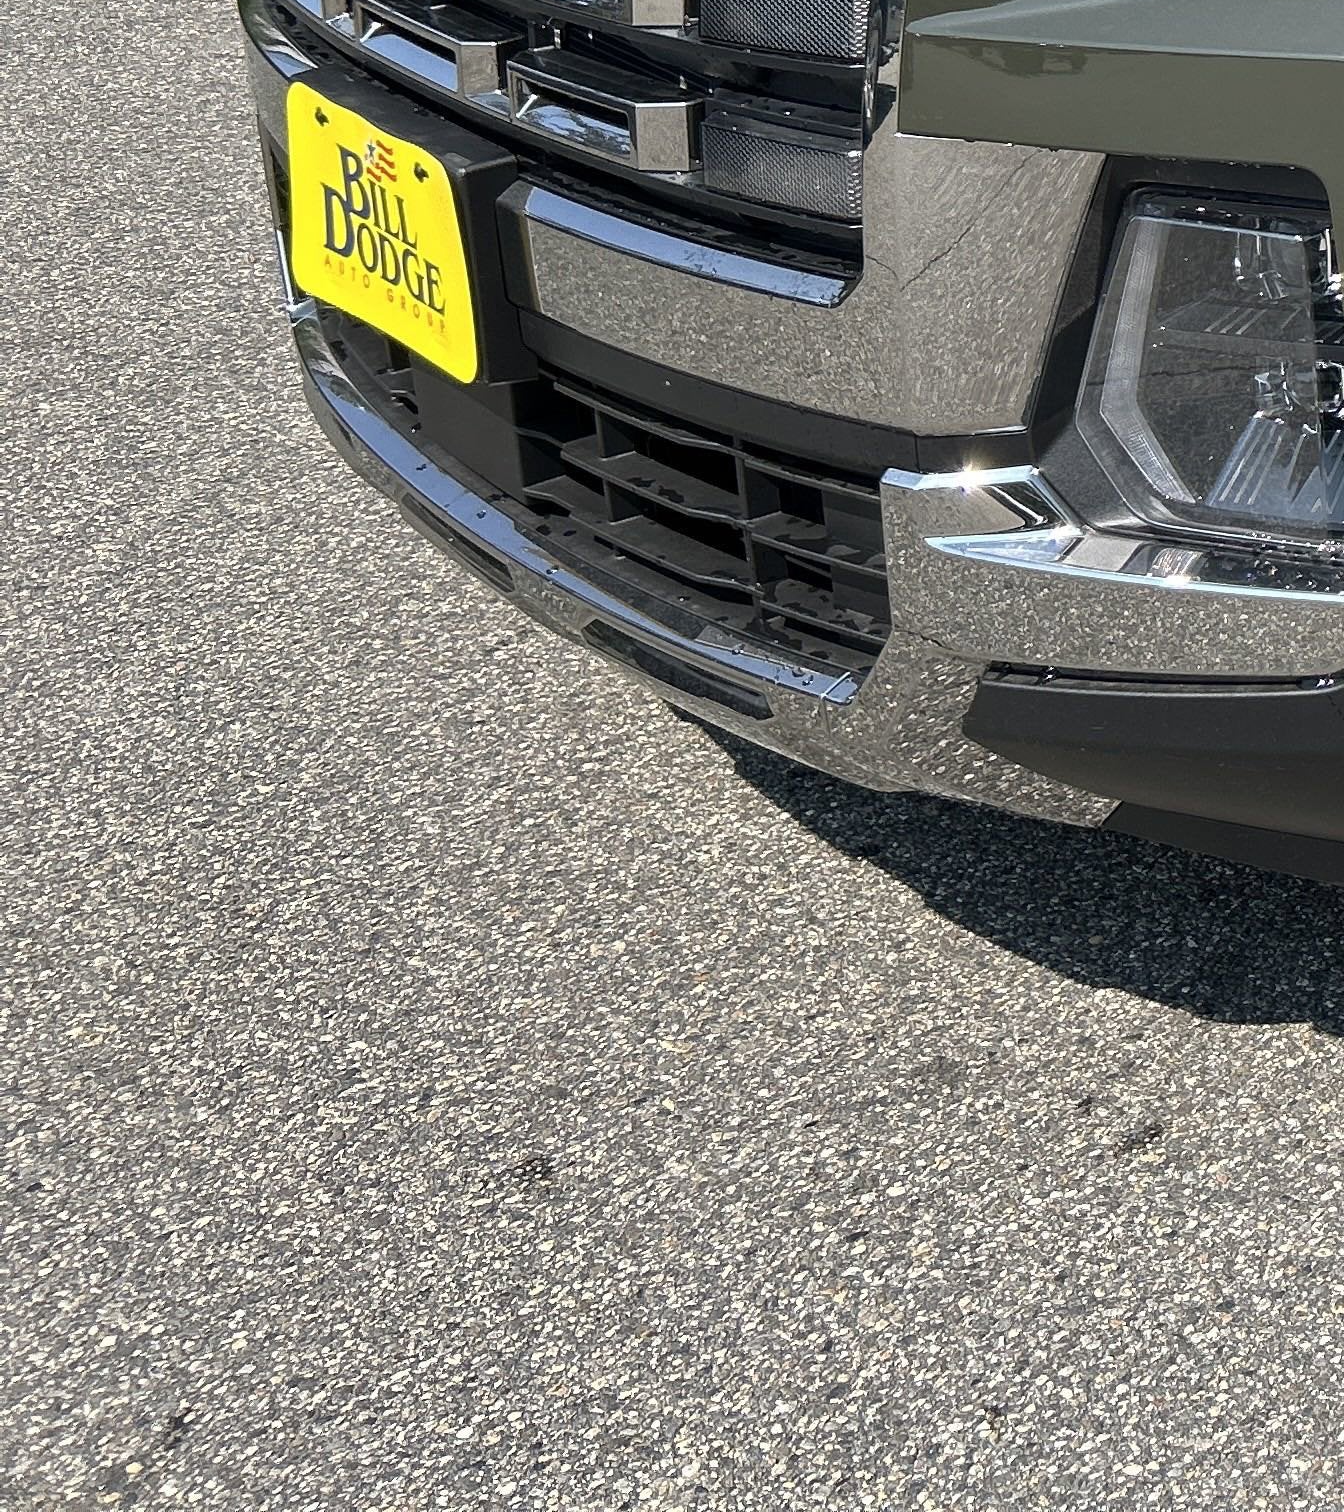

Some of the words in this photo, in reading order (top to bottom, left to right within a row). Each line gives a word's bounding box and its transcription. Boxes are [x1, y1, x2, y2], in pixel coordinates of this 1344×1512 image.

[320, 182, 446, 315] DODGE
[336, 143, 418, 251] BILL
[324, 253, 371, 289] AUTO
[387, 290, 446, 334] GROUP
